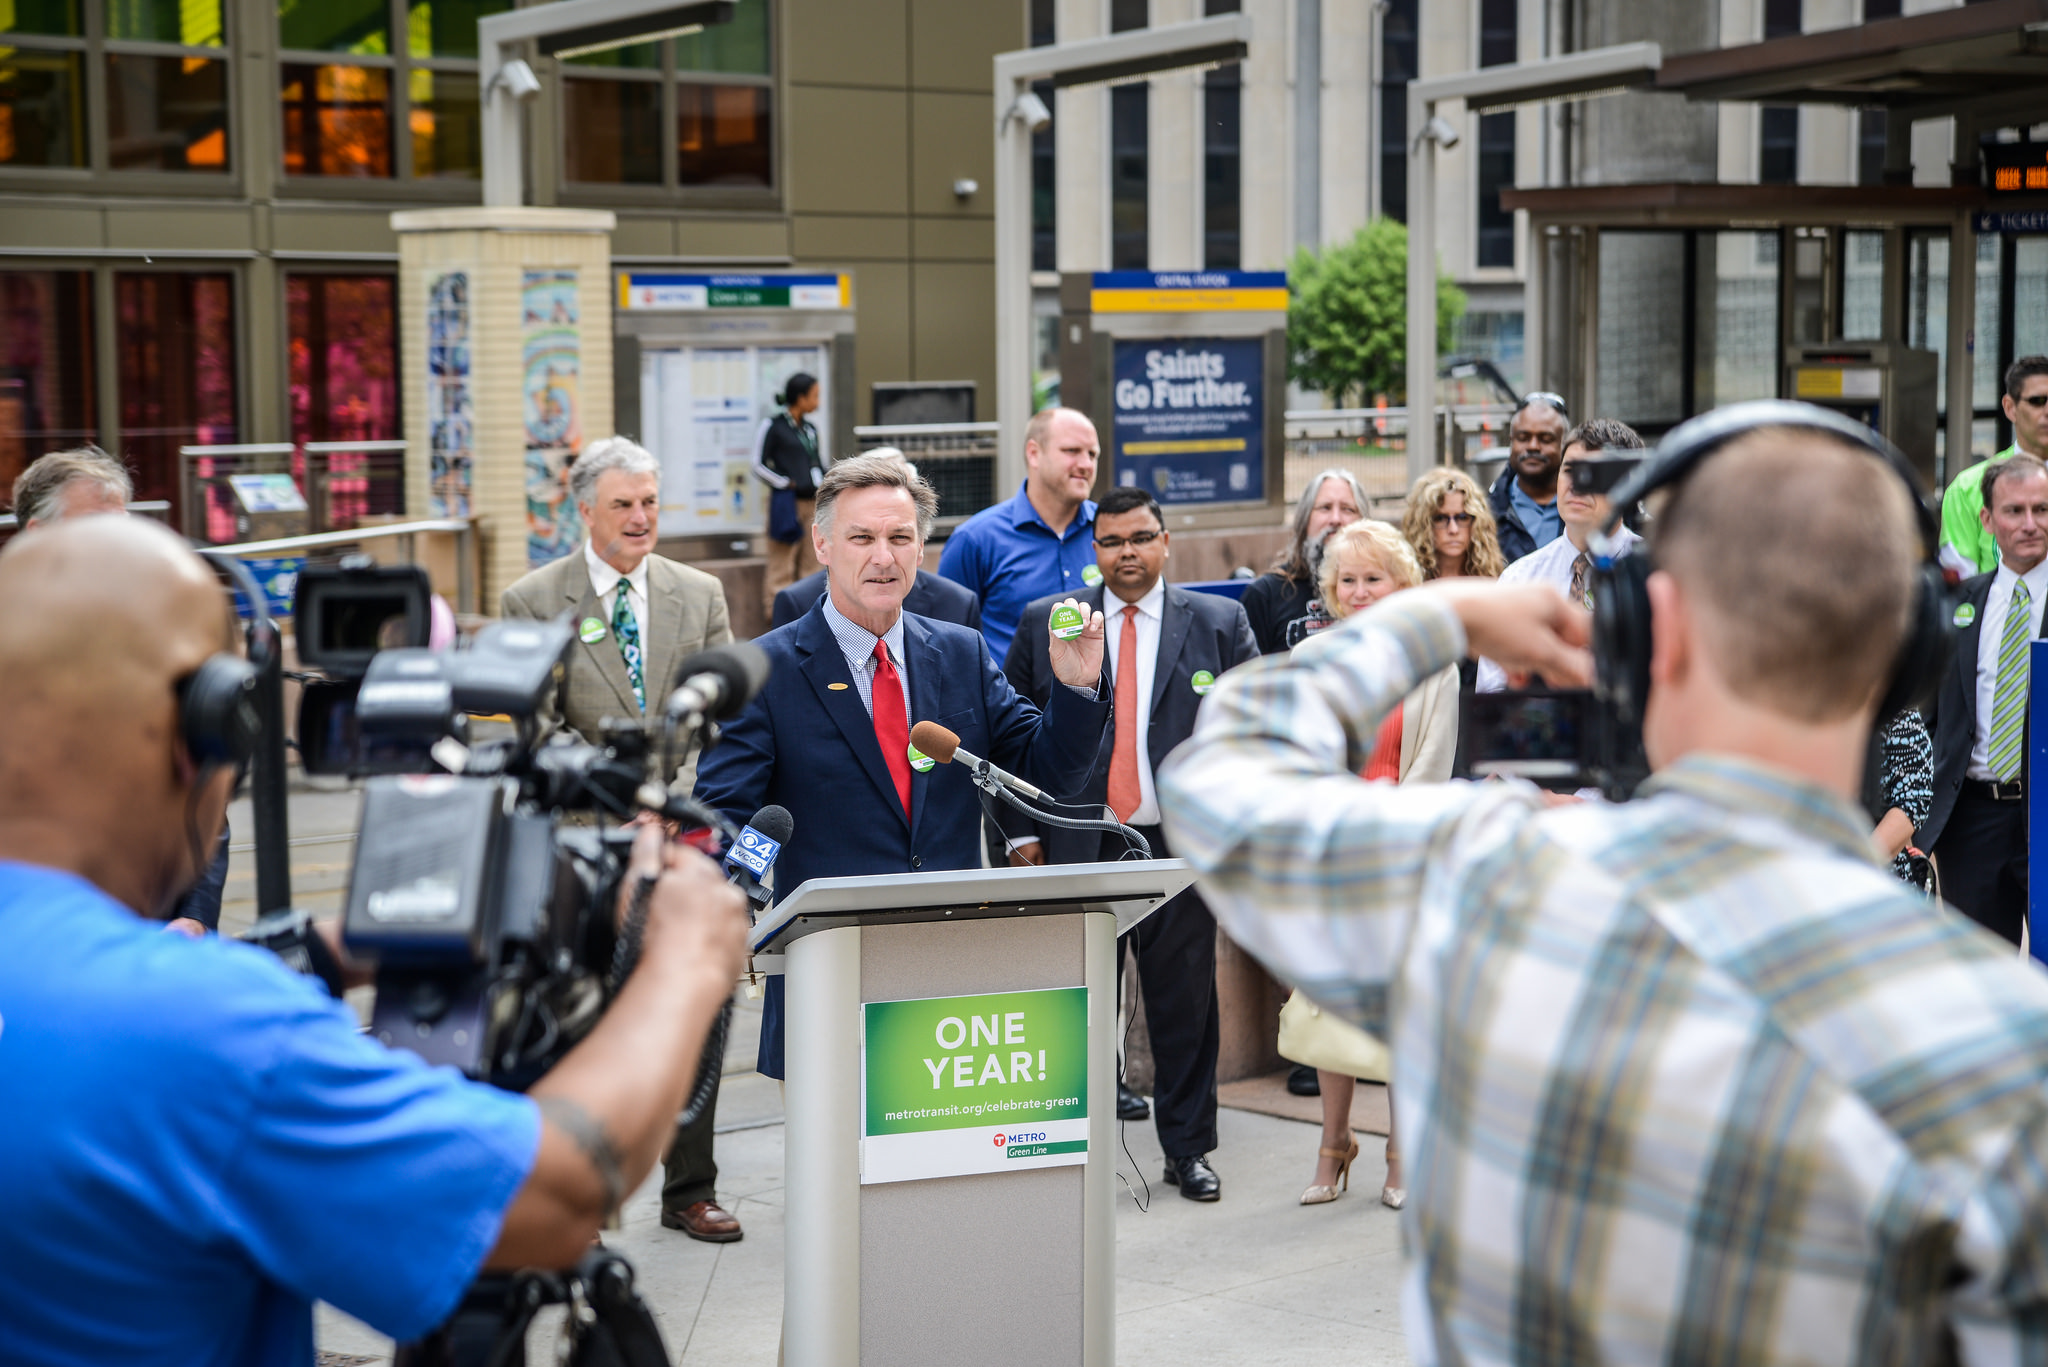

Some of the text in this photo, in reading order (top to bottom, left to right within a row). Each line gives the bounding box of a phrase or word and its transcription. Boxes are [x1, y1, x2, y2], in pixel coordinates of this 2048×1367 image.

[1145, 350, 1225, 379] Saints
[1116, 379, 1252, 409] Go Further.
[735, 848, 763, 868] WCCO
[755, 842, 773, 859] 4
[935, 1012, 1025, 1049] ONE
[923, 1050, 1046, 1089] YEAR!
[885, 1096, 1079, 1121] metrotransit.org/celebrate-green
[1008, 1132, 1047, 1143] METRO
[1008, 1145, 1048, 1157] Green Line
